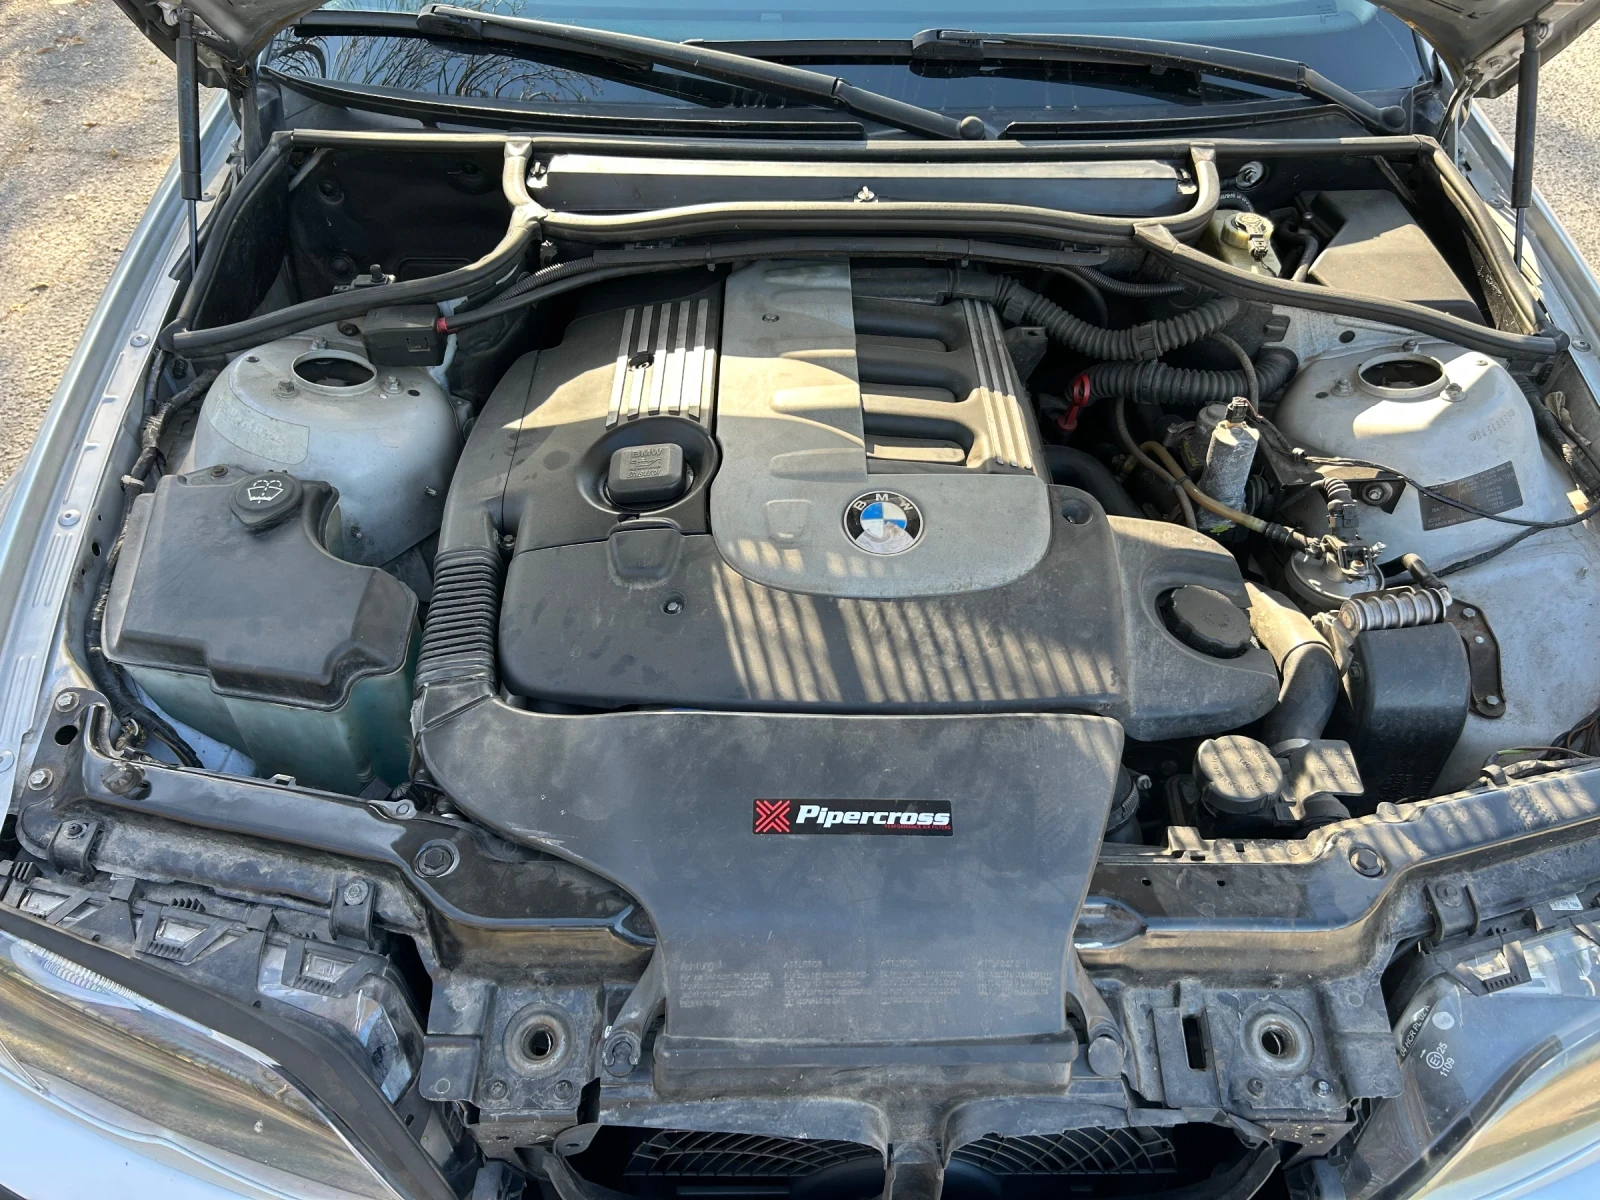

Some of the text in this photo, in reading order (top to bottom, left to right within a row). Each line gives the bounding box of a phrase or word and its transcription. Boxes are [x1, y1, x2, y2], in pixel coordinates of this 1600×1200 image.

[853, 493, 914, 511] BMW
[795, 805, 950, 828] Pipercross
[1412, 1020, 1422, 1032] PL
[1436, 1041, 1448, 1055] 25
[1439, 1057, 1455, 1077] 1109
